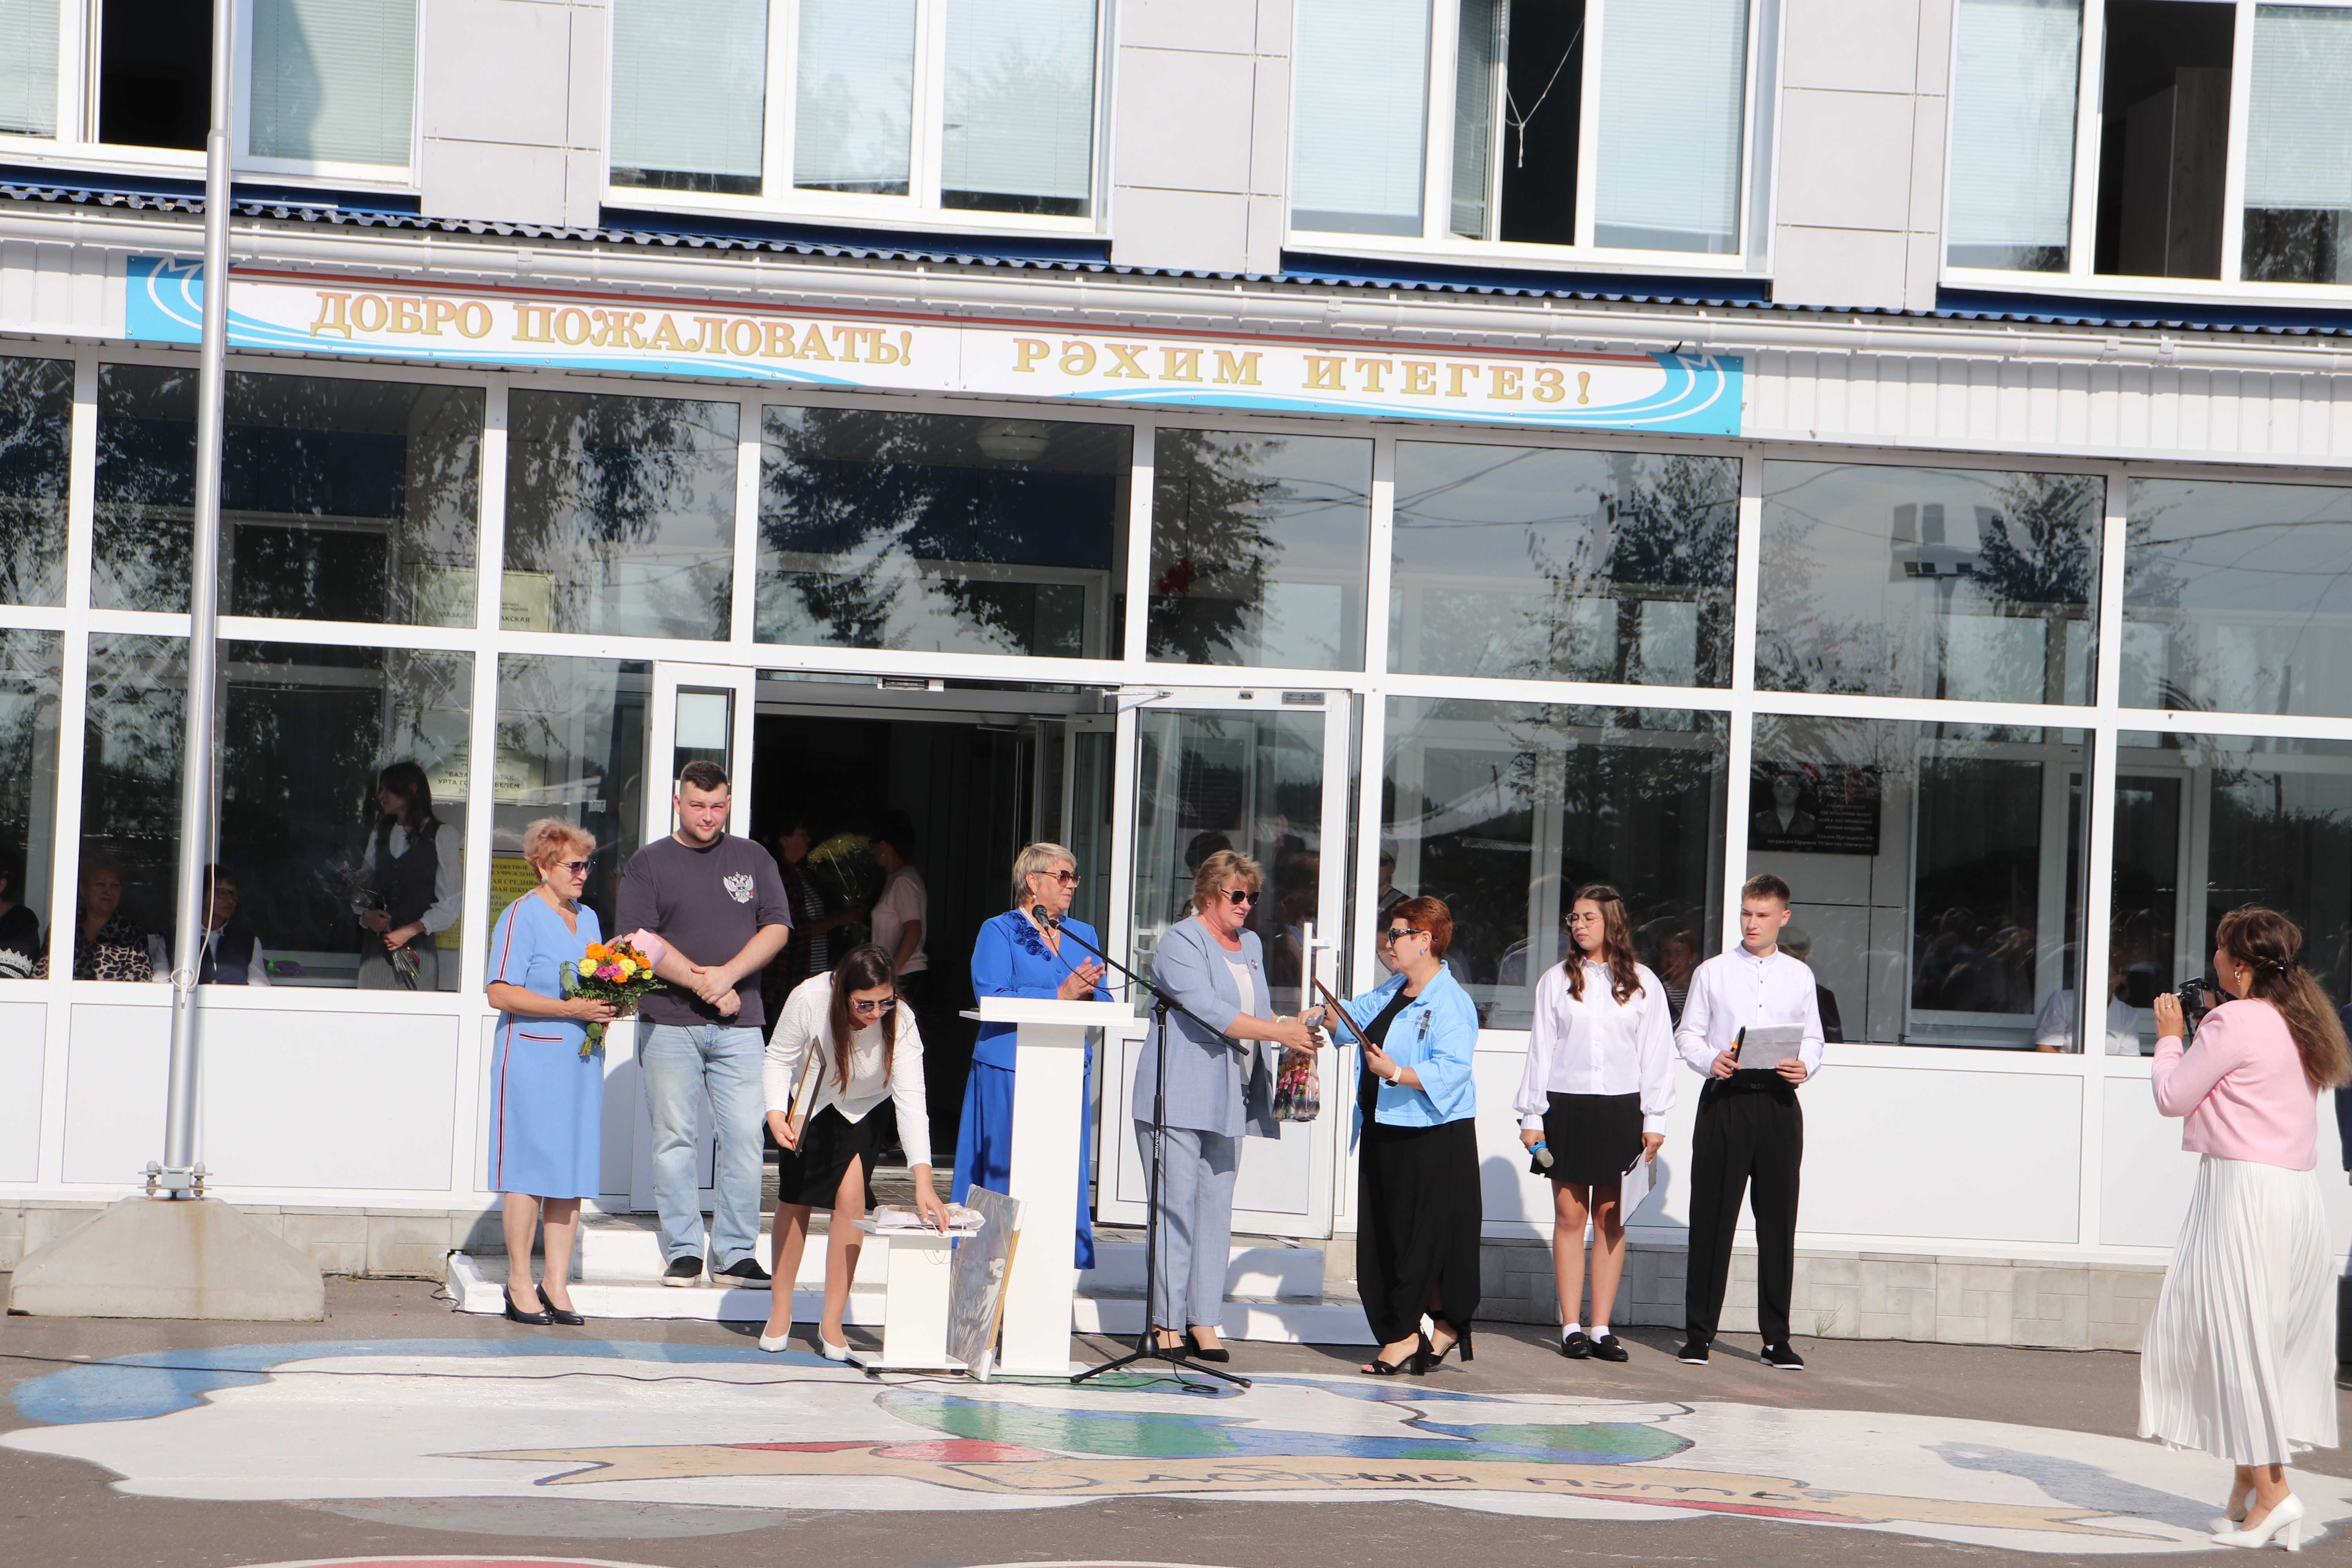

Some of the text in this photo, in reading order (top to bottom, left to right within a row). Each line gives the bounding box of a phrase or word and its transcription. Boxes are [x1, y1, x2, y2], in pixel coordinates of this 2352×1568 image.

[311, 292, 913, 367] ДОБРО ПОЖАЛОВАТЬ!
[1013, 338, 1591, 405] РӘХИМ ИТЕГЕЗ!
